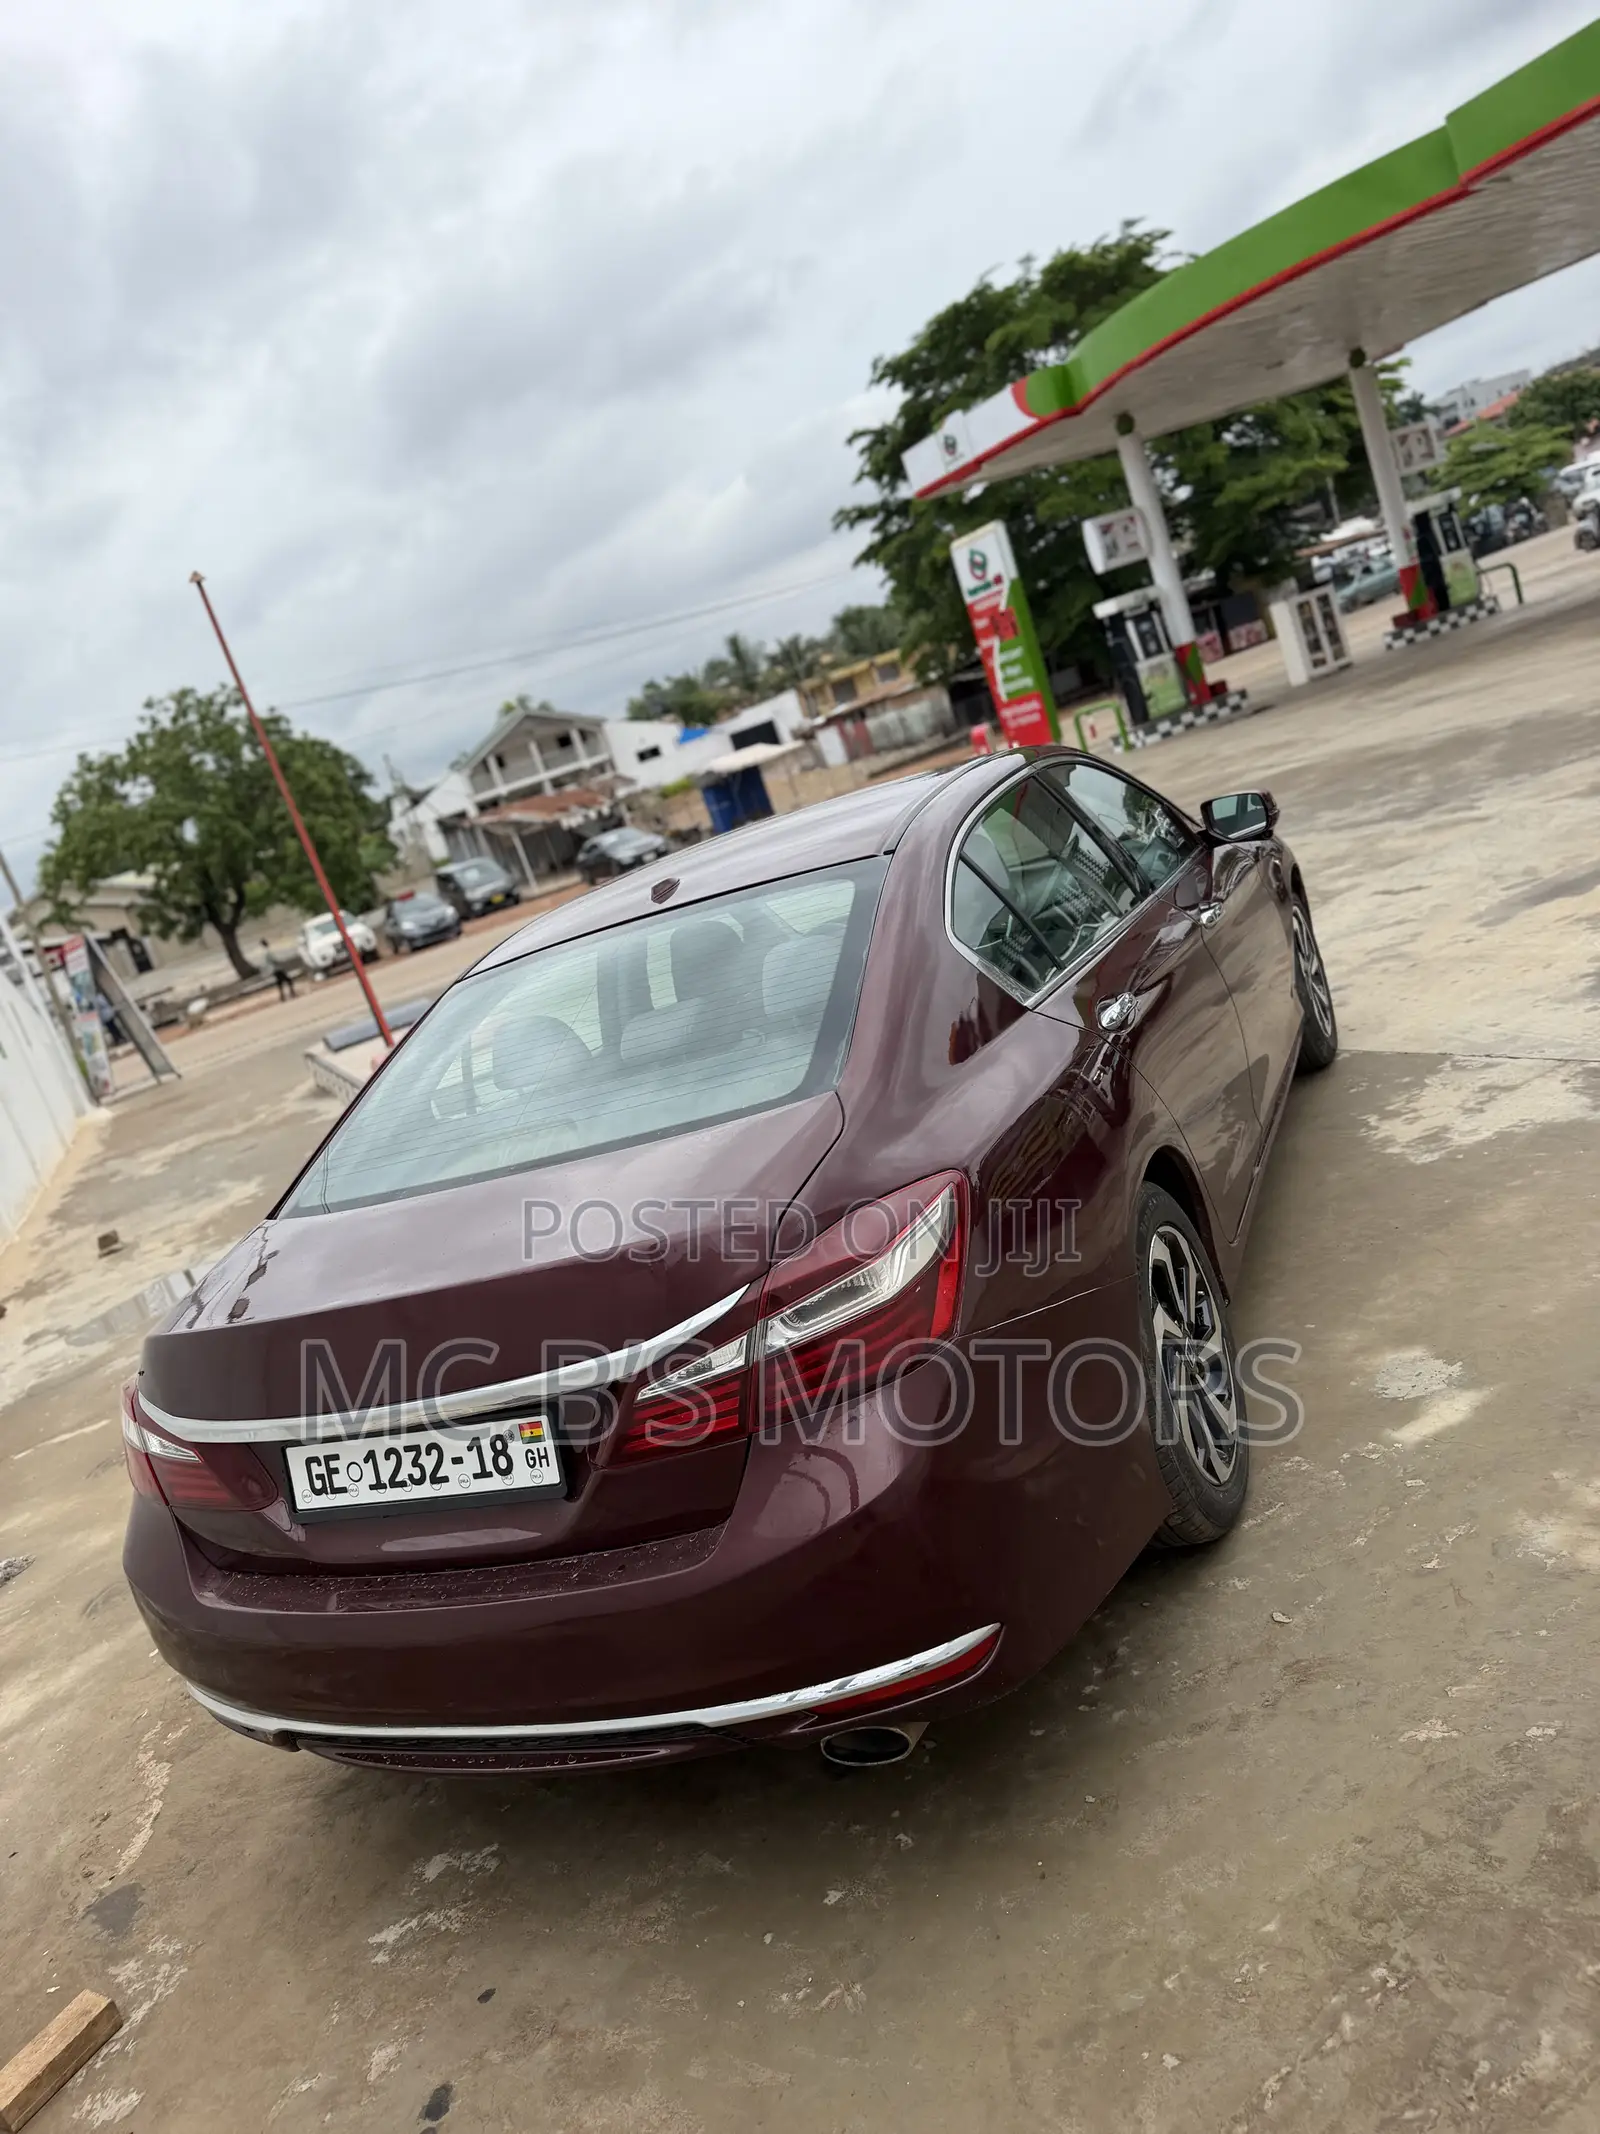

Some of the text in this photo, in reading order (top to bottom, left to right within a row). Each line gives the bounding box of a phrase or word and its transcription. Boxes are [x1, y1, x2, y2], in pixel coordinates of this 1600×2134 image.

[305, 1434, 514, 1496] GE 1232-18
[525, 1446, 550, 1469] GH
